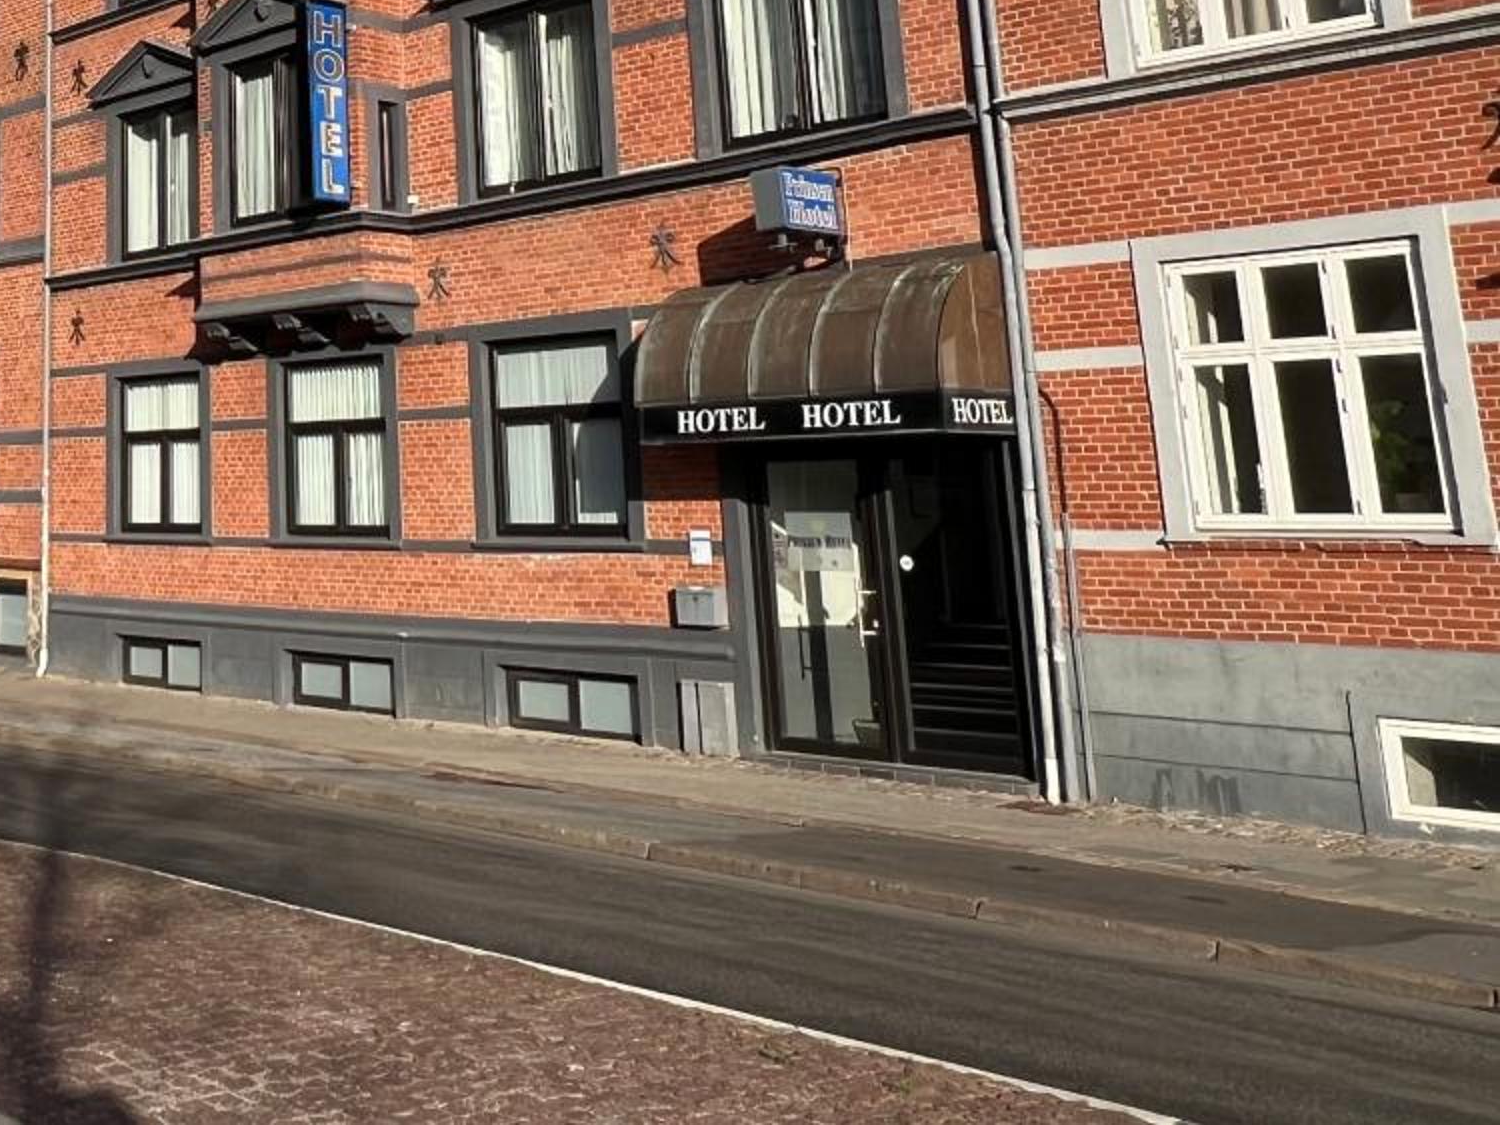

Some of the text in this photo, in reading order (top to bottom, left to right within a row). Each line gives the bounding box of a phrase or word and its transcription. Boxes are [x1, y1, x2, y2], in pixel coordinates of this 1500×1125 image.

[313, 10, 345, 195] HOTEL
[677, 399, 901, 434] HOTEL HOTEL
[951, 397, 1014, 424] HOTEL
